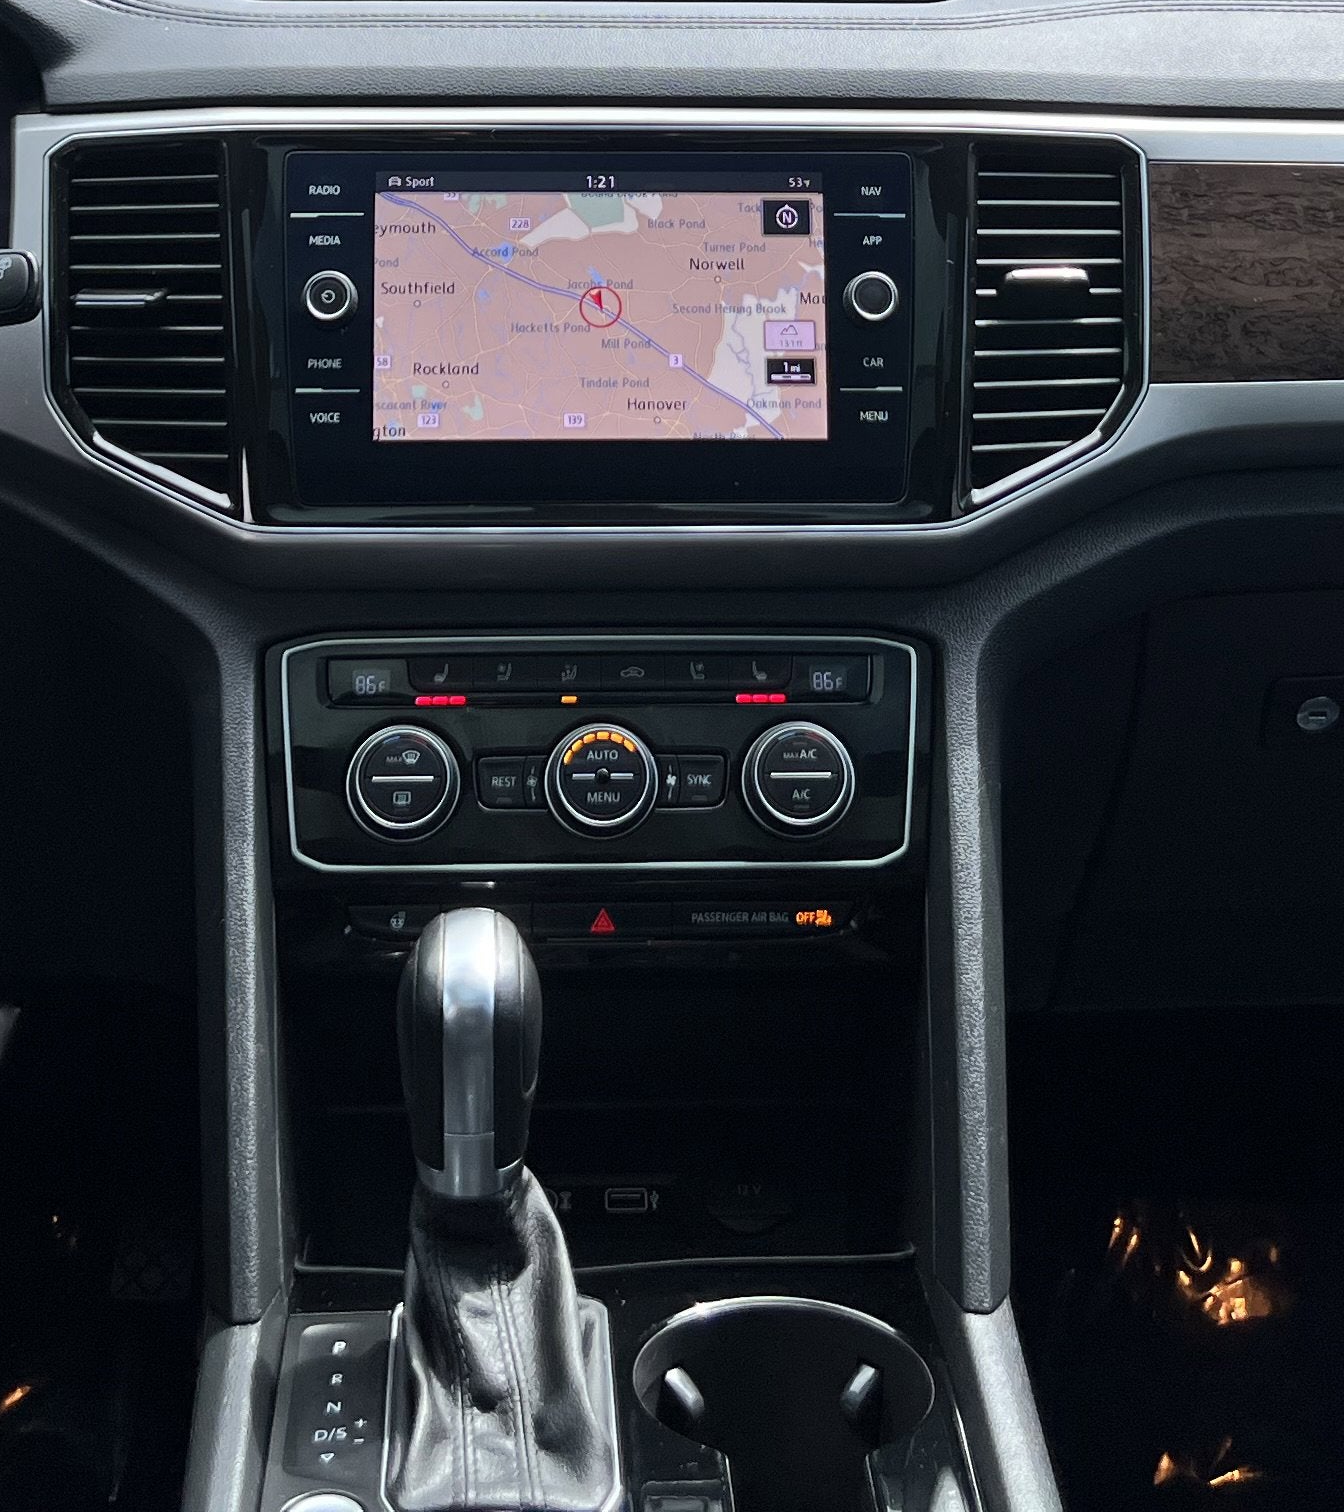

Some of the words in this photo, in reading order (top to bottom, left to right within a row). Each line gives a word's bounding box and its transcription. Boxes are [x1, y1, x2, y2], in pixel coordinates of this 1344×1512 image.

[405, 175, 435, 188] Sport
[586, 175, 615, 189] 1:21
[308, 185, 341, 196] RADIO
[860, 186, 882, 197] NAV
[511, 218, 530, 230] 228
[647, 219, 675, 229] Black
[678, 219, 706, 229] Pond
[782, 212, 792, 224] N
[308, 235, 341, 246] MEDIA
[862, 235, 883, 246] APP
[471, 245, 509, 258] Accord
[511, 245, 539, 258] Pond
[703, 242, 736, 253] Turner
[738, 242, 766, 253] Pond
[689, 258, 746, 271] Norwell
[380, 282, 456, 295] Southfield
[566, 279, 604, 290] Jacobs
[606, 279, 634, 290] Pond
[672, 303, 711, 314] Second
[714, 303, 752, 316] Herring
[755, 303, 786, 314] Brook
[511, 323, 560, 333] Hacketts
[563, 323, 591, 333] Pond
[601, 338, 620, 349] Mill
[623, 338, 652, 349] Pond
[307, 358, 343, 369] PHONE
[672, 355, 679, 365] 3
[862, 357, 884, 368] CAR
[412, 362, 480, 376] Rockland
[783, 361, 789, 373] 1
[790, 364, 801, 373] mi
[580, 377, 619, 389] Tindale
[621, 377, 650, 389] Pond
[420, 399, 448, 411] River
[626, 398, 687, 412] Hanover
[746, 398, 791, 410] Oakman
[794, 398, 822, 410] Pond
[309, 412, 341, 423] VOICE
[421, 415, 437, 426] 123
[567, 414, 583, 426] 139
[859, 410, 889, 422] MENU
[586, 749, 619, 761] AUTO
[799, 748, 817, 760] A/C
[491, 775, 517, 788] REST
[686, 774, 713, 786] SYNC
[586, 792, 621, 804] MENU
[791, 788, 811, 800] A/C
[691, 911, 750, 924] PASSENGER
[750, 911, 768, 923] AIR
[768, 911, 790, 923] BAG
[795, 911, 816, 925] OFF
[331, 1340, 347, 1355] P
[331, 1373, 343, 1385] R
[326, 1400, 342, 1414] N
[313, 1426, 348, 1443] D/S
